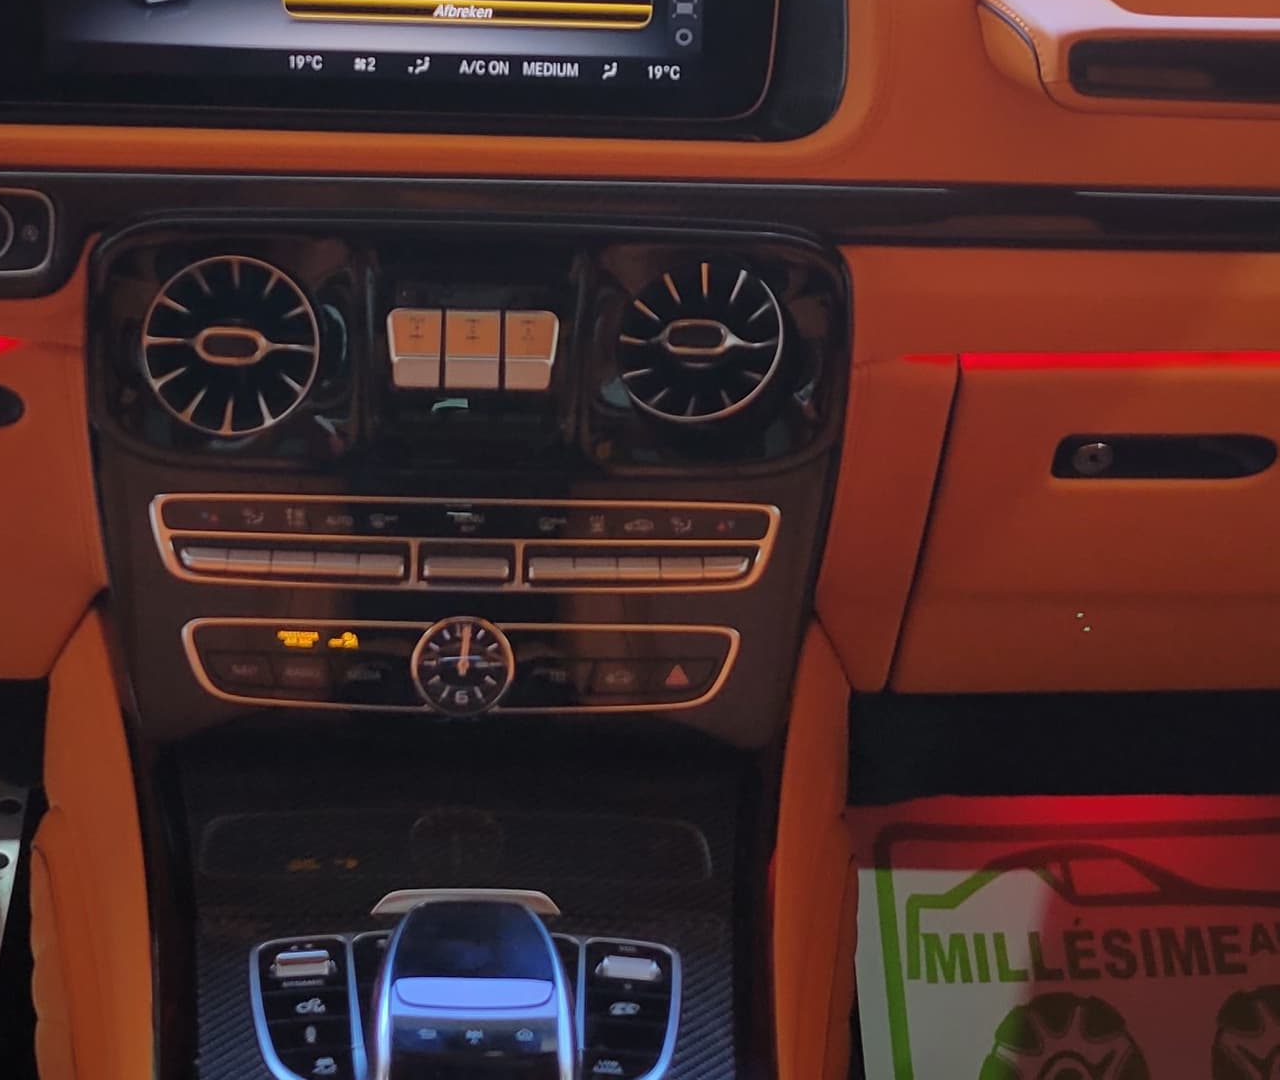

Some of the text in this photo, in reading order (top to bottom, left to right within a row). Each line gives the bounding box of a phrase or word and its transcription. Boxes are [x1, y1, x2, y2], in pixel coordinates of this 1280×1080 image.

[433, 4, 493, 19] Afbreken
[288, 55, 323, 71] 19°C
[459, 59, 510, 76] A/C ON
[522, 62, 579, 77] MEDIUM
[647, 65, 681, 80] 19°C
[455, 690, 469, 704] 6
